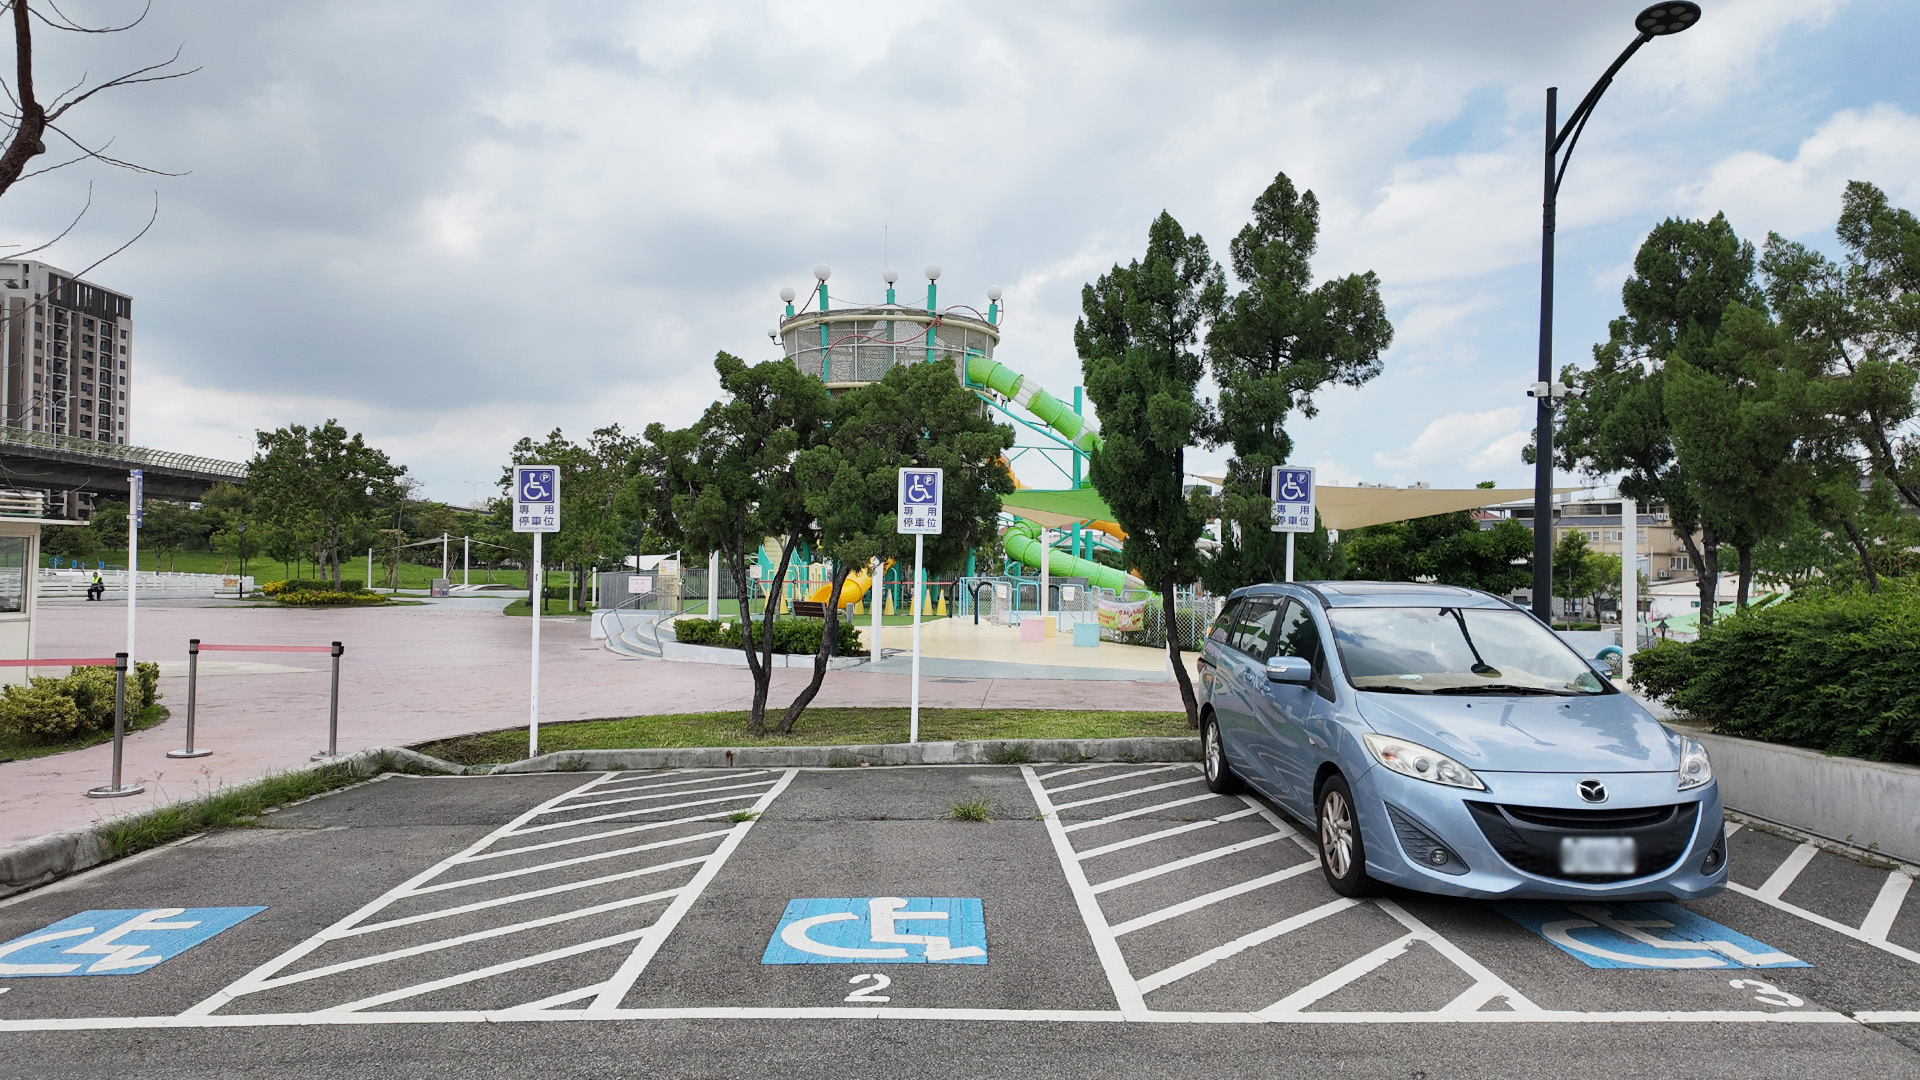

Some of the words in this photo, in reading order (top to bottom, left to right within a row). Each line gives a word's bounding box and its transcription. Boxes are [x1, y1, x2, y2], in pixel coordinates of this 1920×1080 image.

[542, 474, 549, 482] P
[925, 476, 932, 484] P
[1299, 474, 1305, 482] P
[519, 505, 554, 514] 專用
[904, 506, 937, 516] 專用
[1277, 505, 1310, 515] 專用
[519, 516, 554, 526] 停車位
[904, 517, 937, 527] 停車位
[843, 973, 891, 1002] 2
[1728, 978, 1805, 1007] 3
